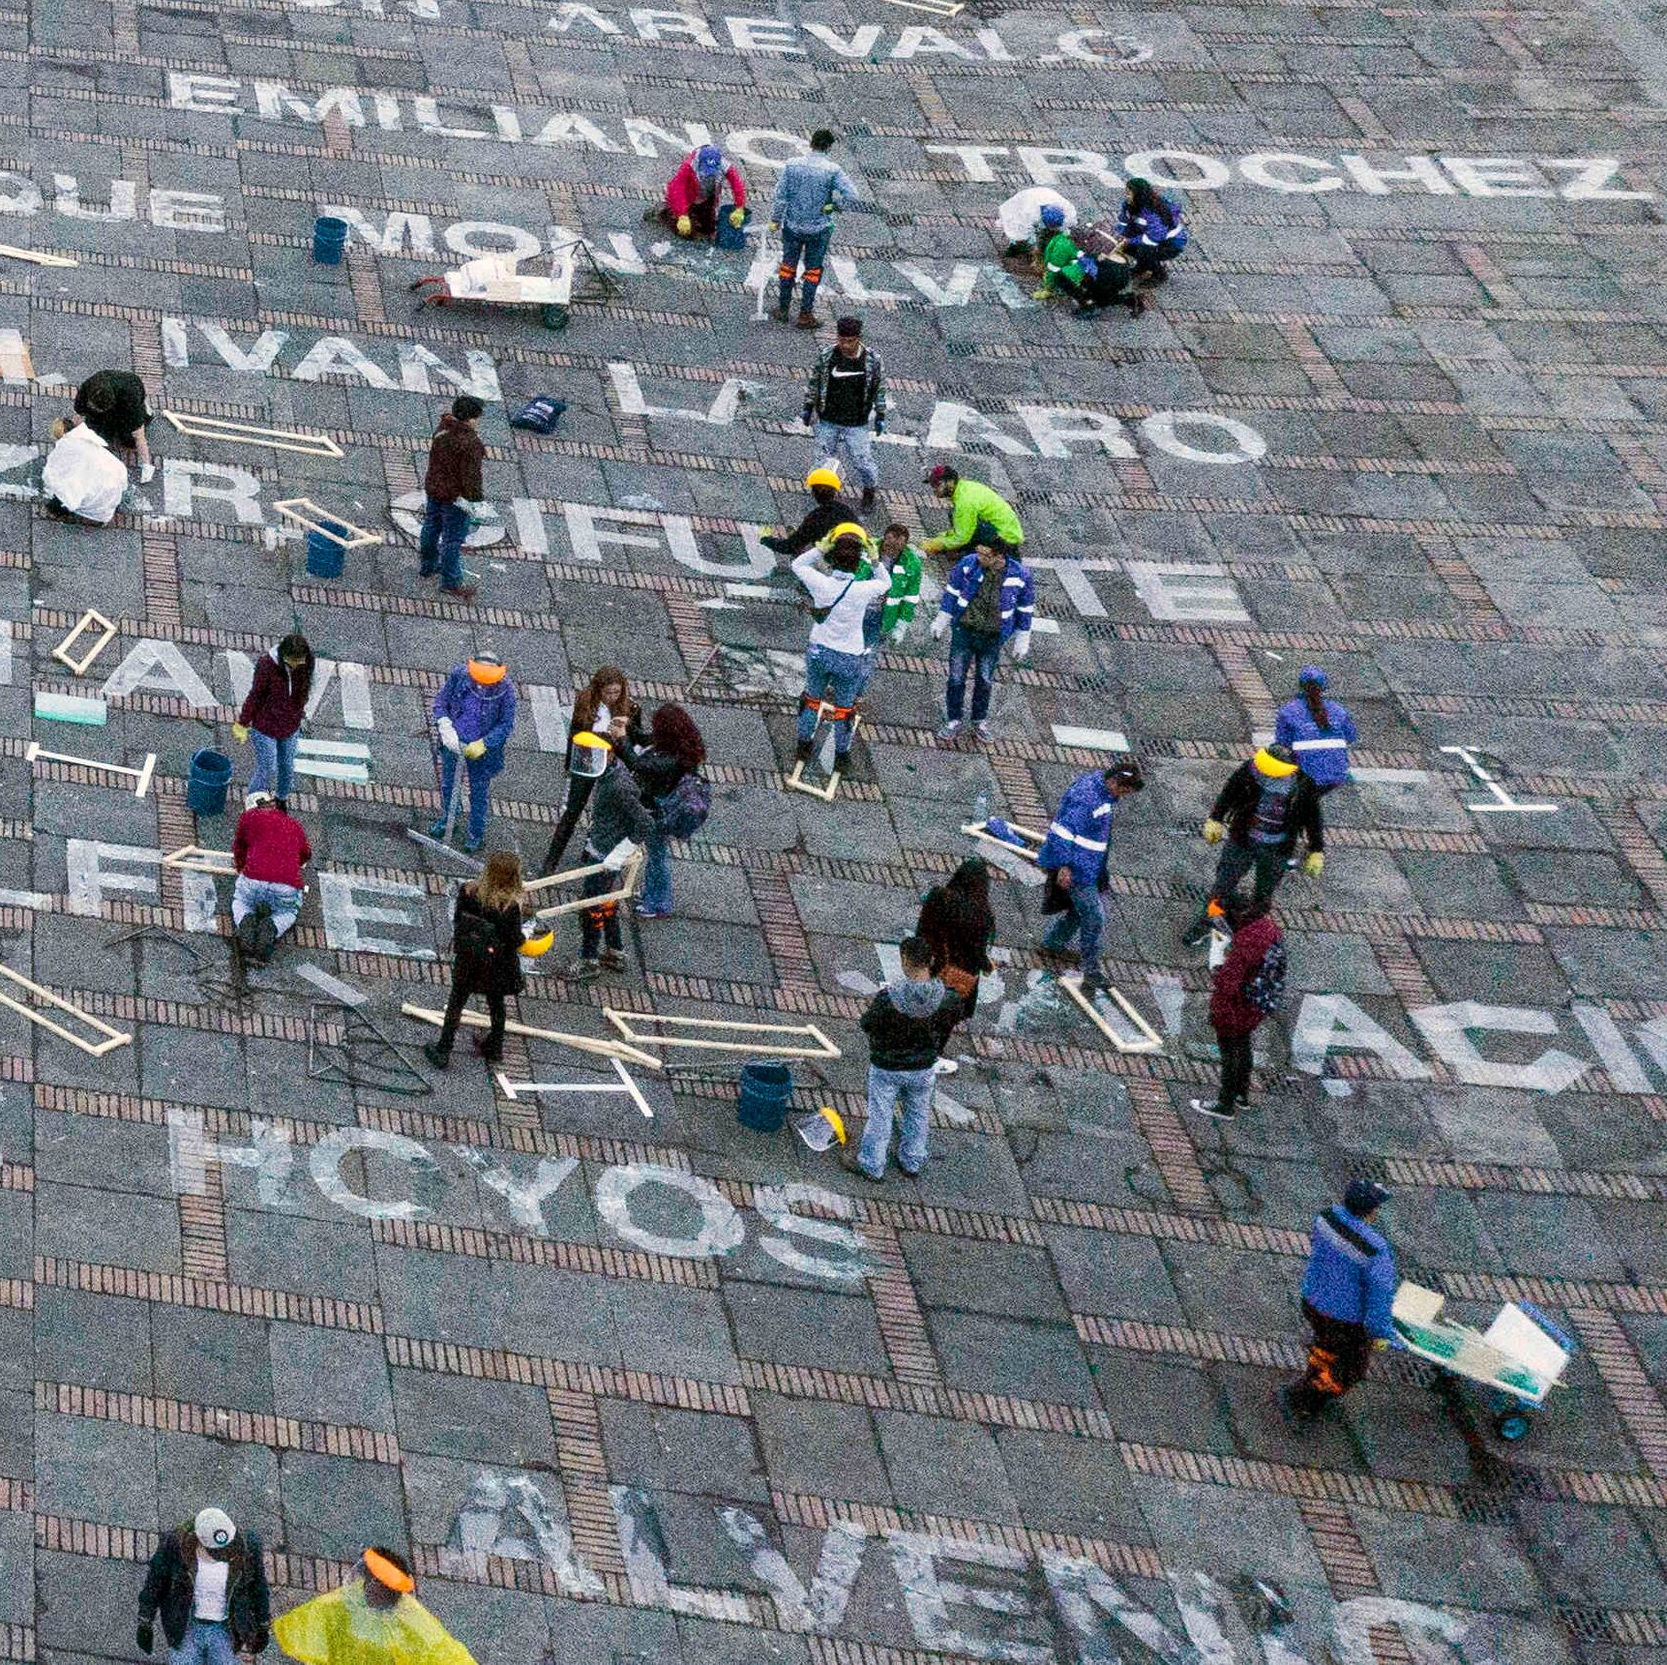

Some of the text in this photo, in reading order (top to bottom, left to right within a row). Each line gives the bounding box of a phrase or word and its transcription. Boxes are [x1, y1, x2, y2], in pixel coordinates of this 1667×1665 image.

[167, 70, 1655, 205] EMILIANO TROCHEZ
[161, 317, 503, 403] IVAN
